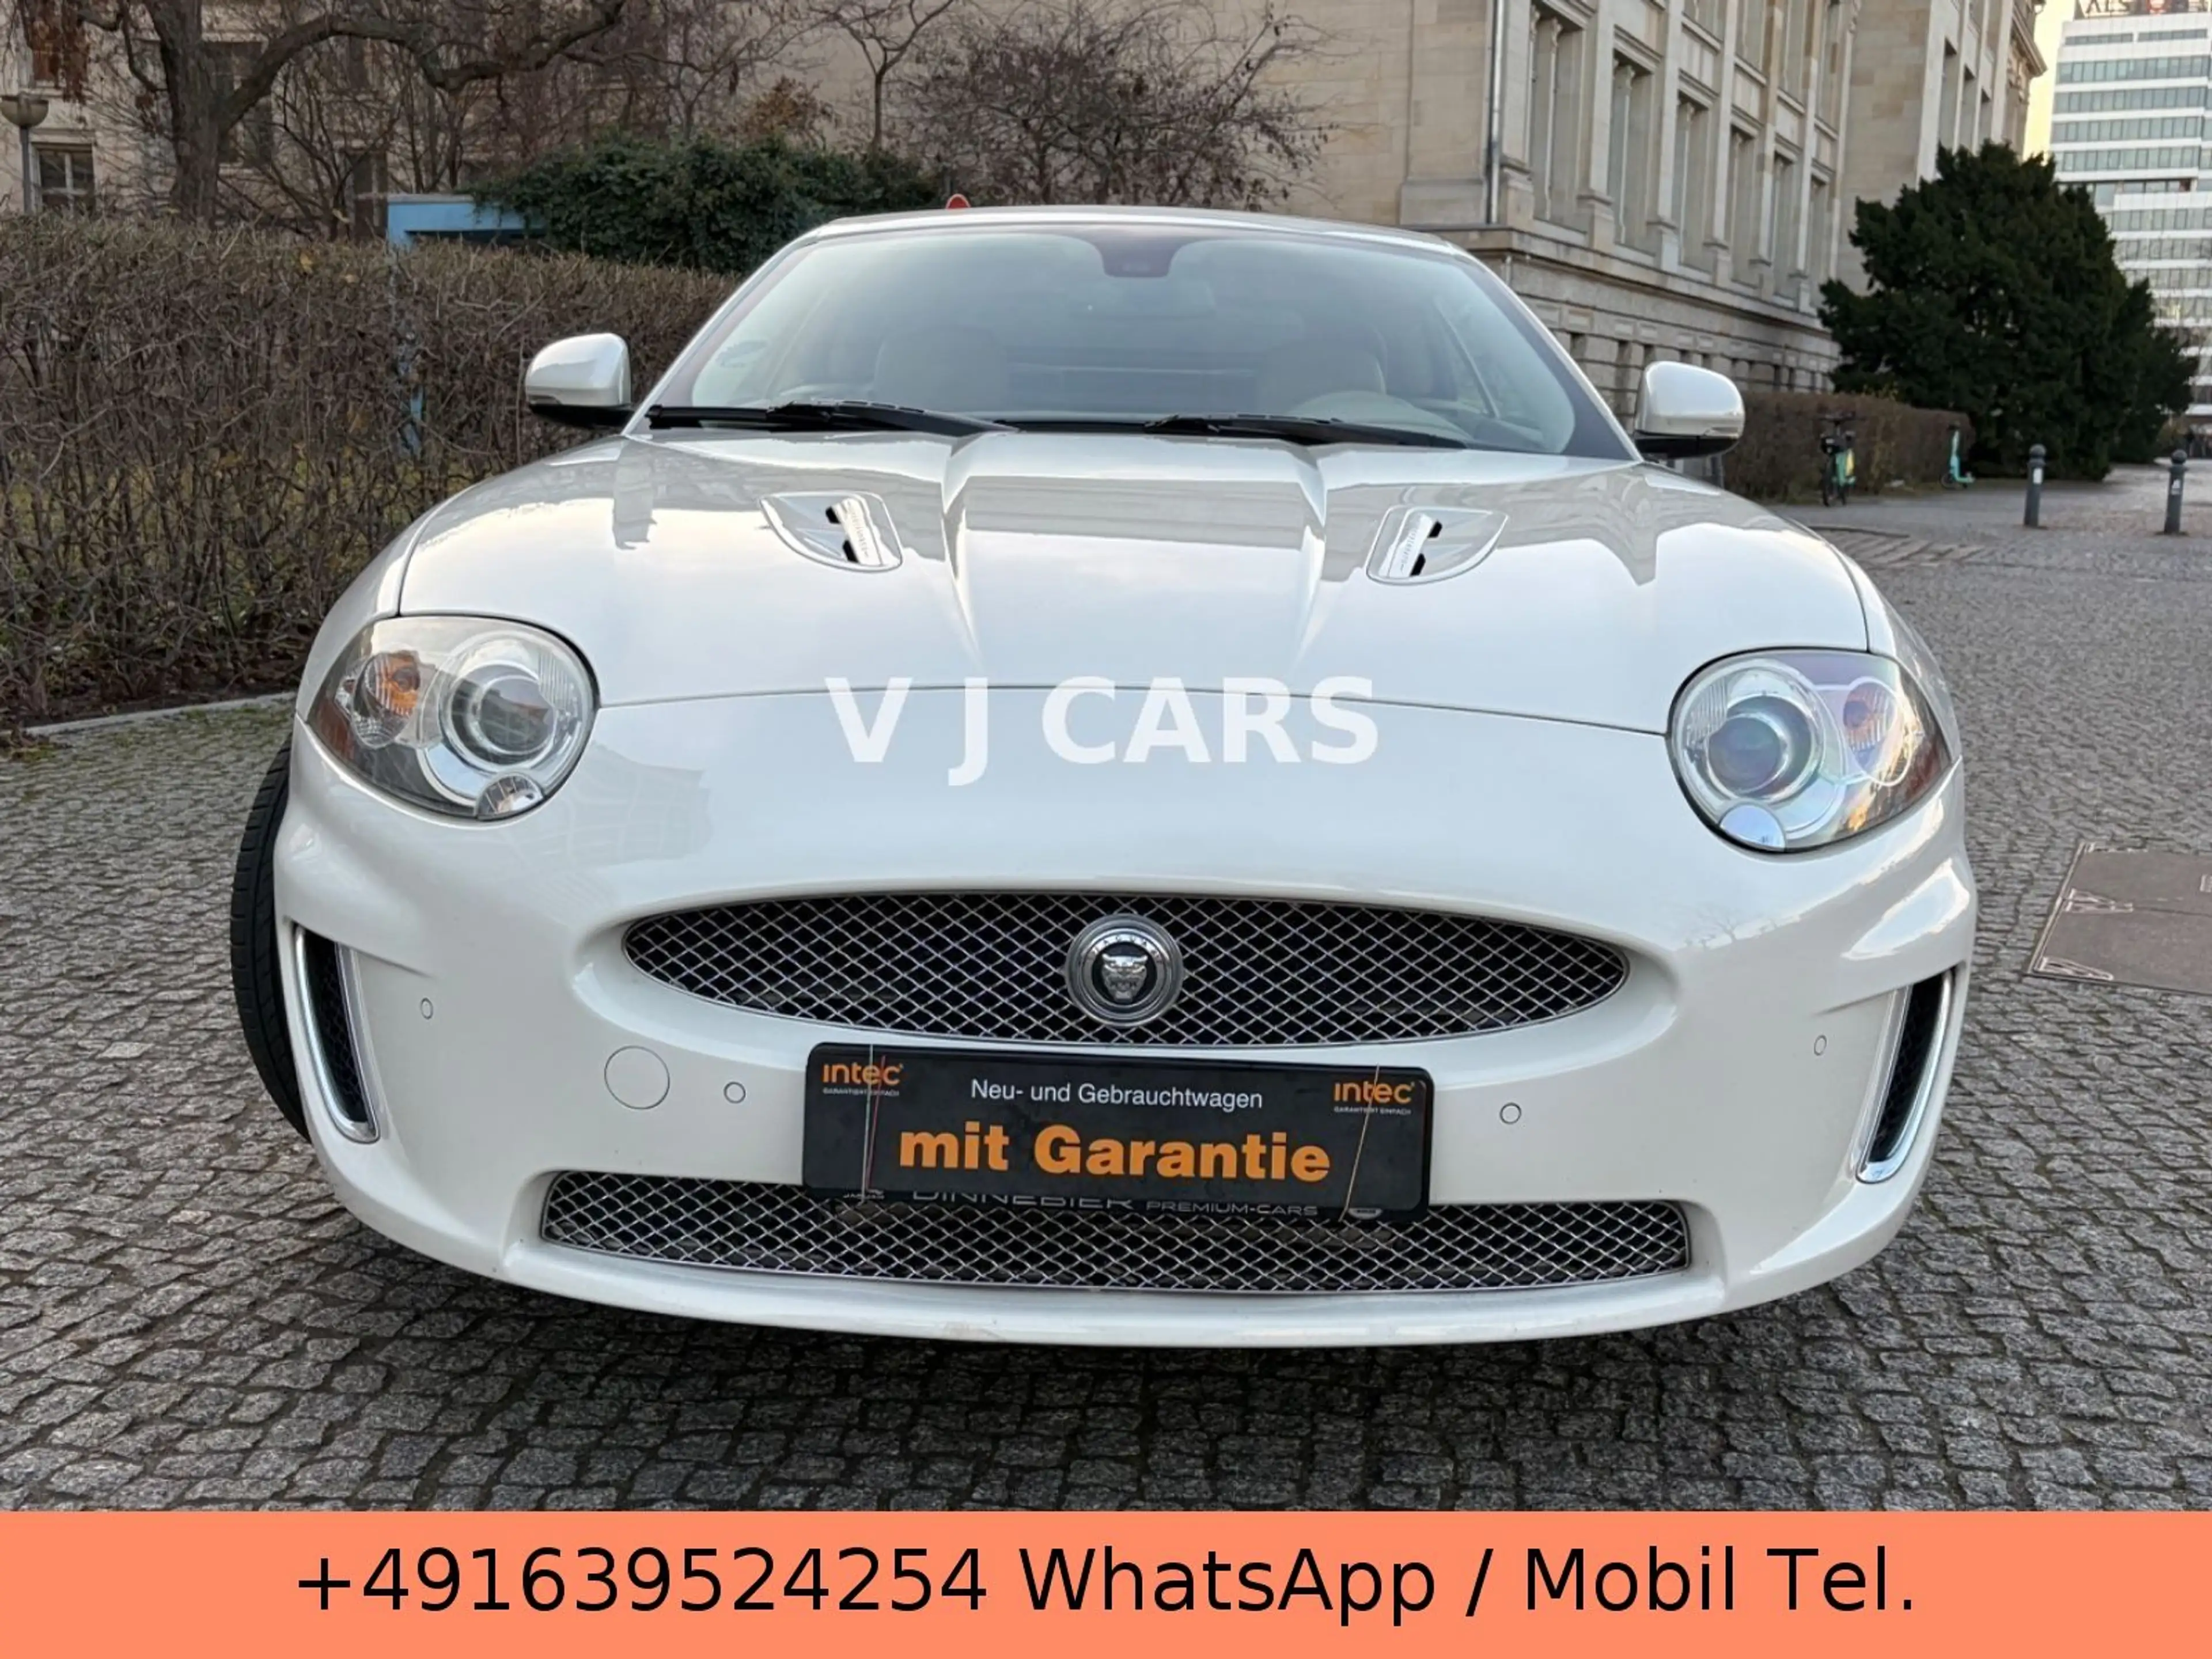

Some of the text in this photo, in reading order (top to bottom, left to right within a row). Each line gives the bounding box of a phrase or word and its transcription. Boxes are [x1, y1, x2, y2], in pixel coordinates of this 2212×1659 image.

[823, 1062, 901, 1086] intec
[971, 1079, 1263, 1113] Neu- und Gebrauchtwagen
[1334, 1081, 1412, 1104] intec
[899, 1120, 1331, 1182] mit Garantie
[1146, 1200, 1319, 1216] PREMIUM-CARS
